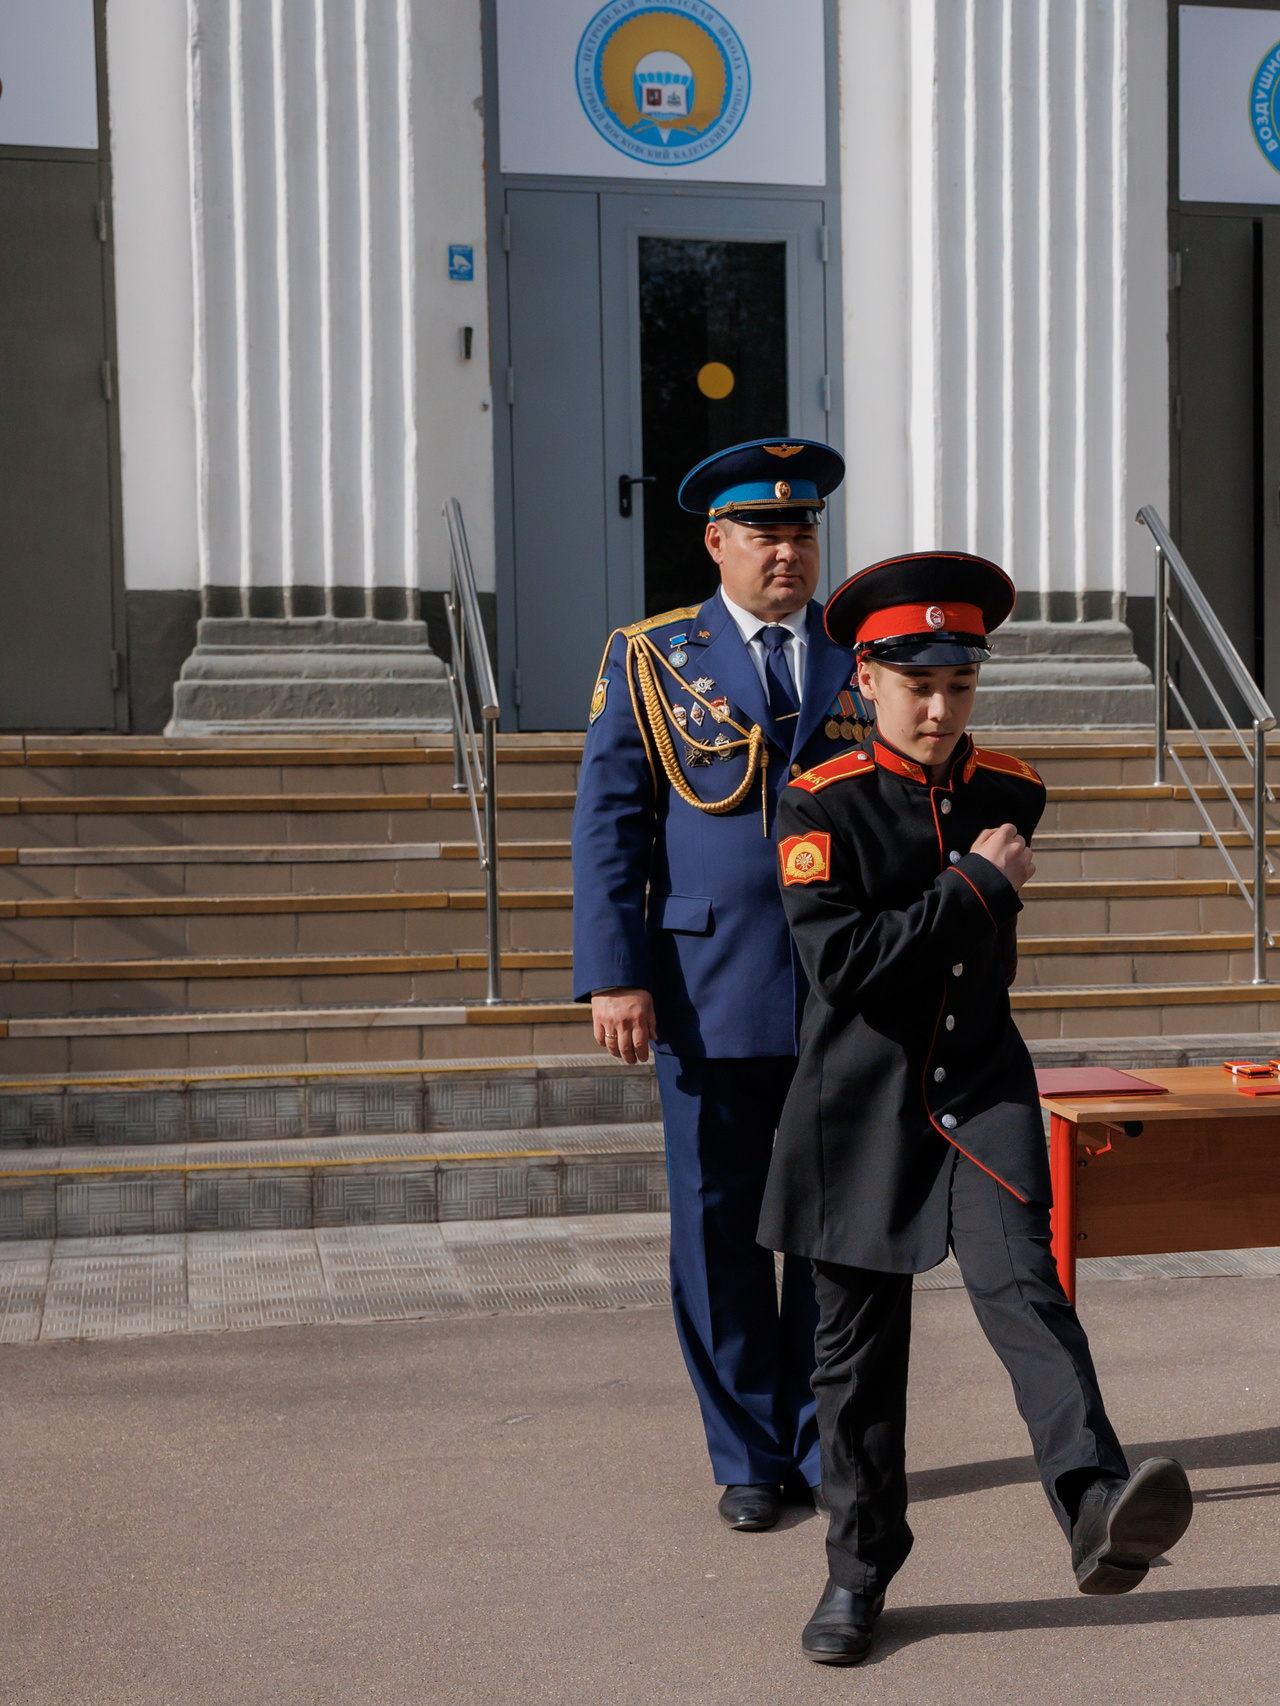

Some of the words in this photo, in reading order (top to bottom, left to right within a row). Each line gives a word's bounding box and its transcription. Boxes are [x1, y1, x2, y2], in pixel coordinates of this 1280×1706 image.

[583, 0, 636, 62] ПЕТРОВСКАЯ
[718, 26, 743, 70] ШКОЛА
[583, 77, 605, 122] ПЕРВЫЙ
[603, 122, 669, 159] МОСКОВСКИЙ
[673, 125, 727, 158] КАДЕТСКИЙ
[724, 86, 743, 125] КОРПУС
